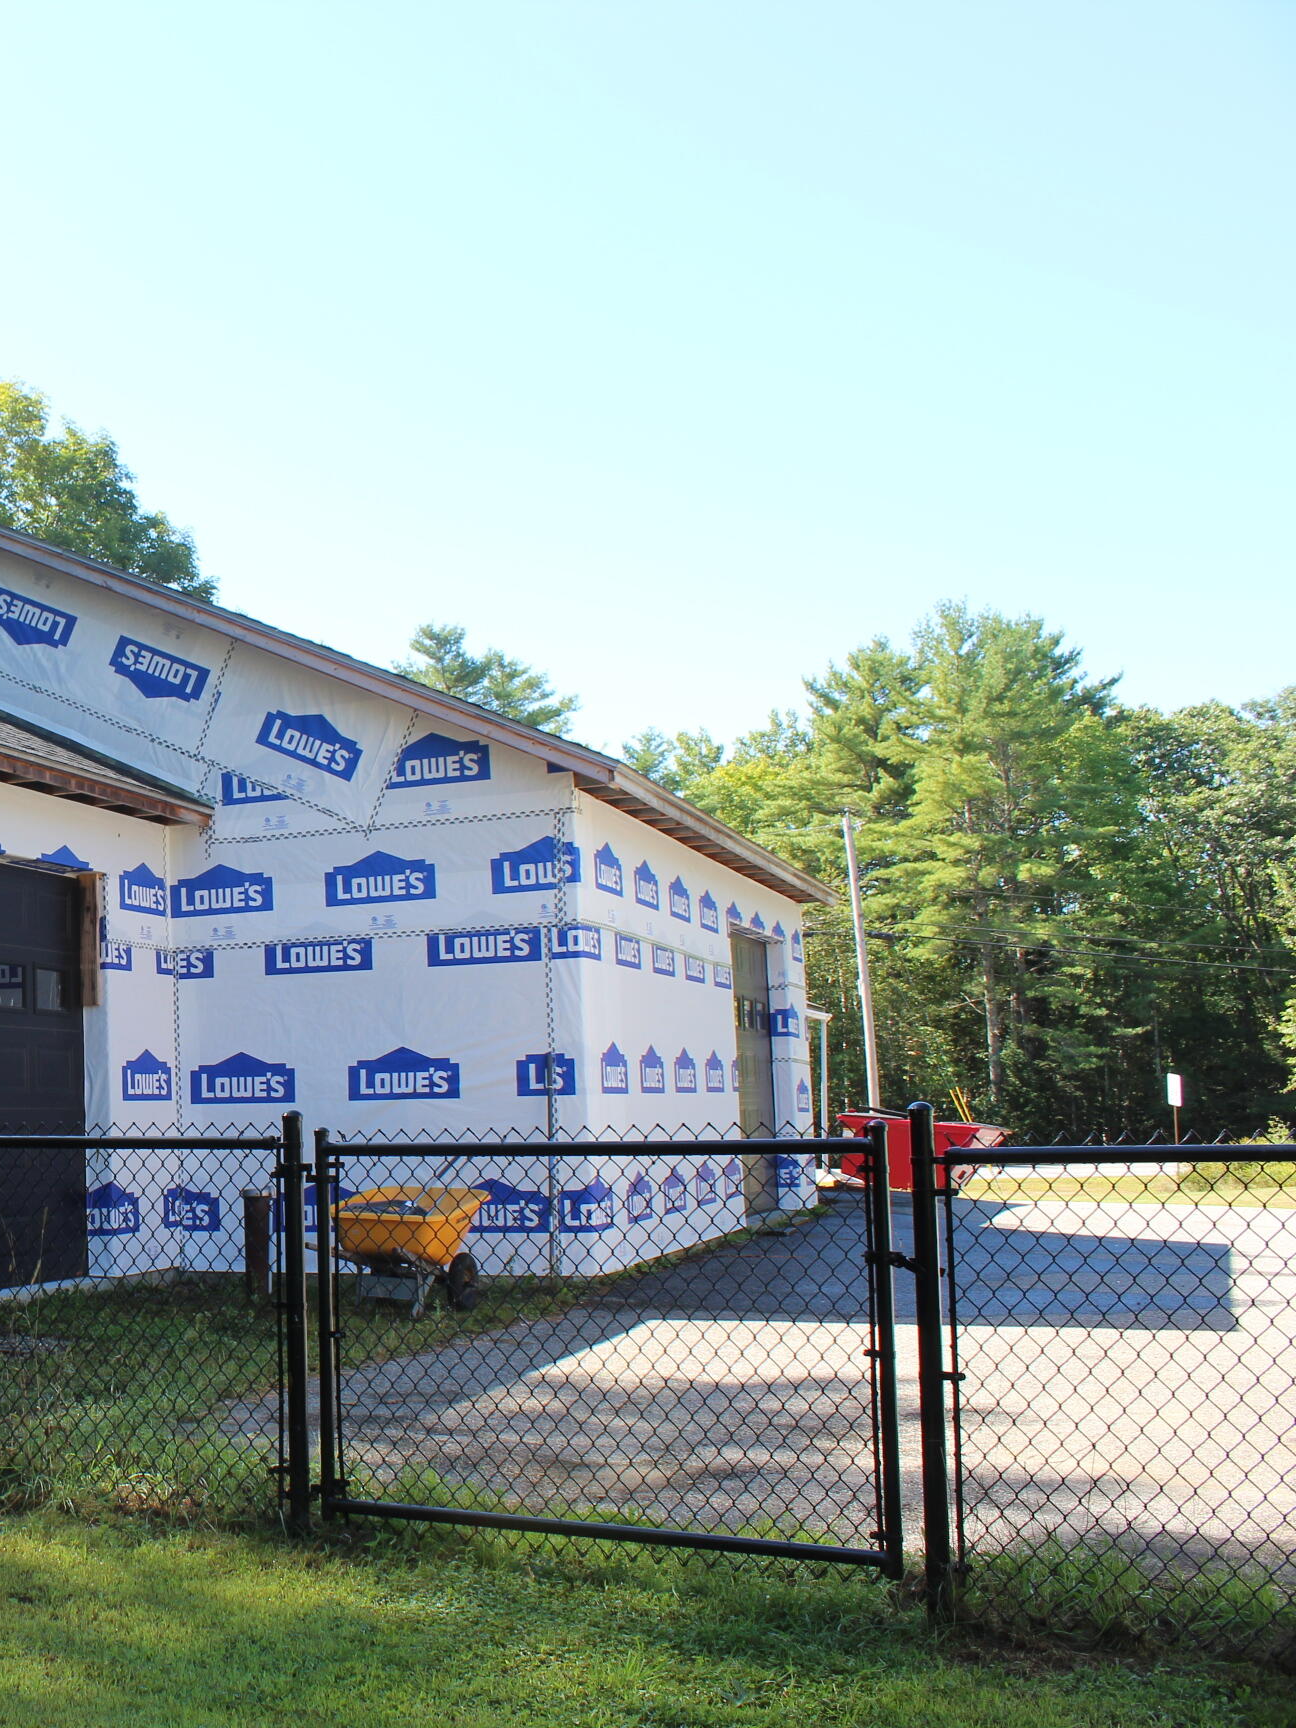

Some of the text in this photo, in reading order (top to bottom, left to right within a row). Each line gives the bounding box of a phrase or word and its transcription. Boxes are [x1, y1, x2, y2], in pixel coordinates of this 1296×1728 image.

[120, 644, 198, 694] LOWE'S
[267, 718, 350, 772] LOWE'S
[124, 879, 165, 911] LOWE'S
[180, 881, 264, 912] LOWE'S
[336, 869, 426, 900] LOWE'S
[276, 941, 362, 969] LOWE'S
[439, 930, 531, 961] LOWE'S
[127, 1069, 168, 1096] LOWE'S
[200, 1072, 286, 1098] LOWE'S
[359, 1067, 450, 1095] LOWE'S
